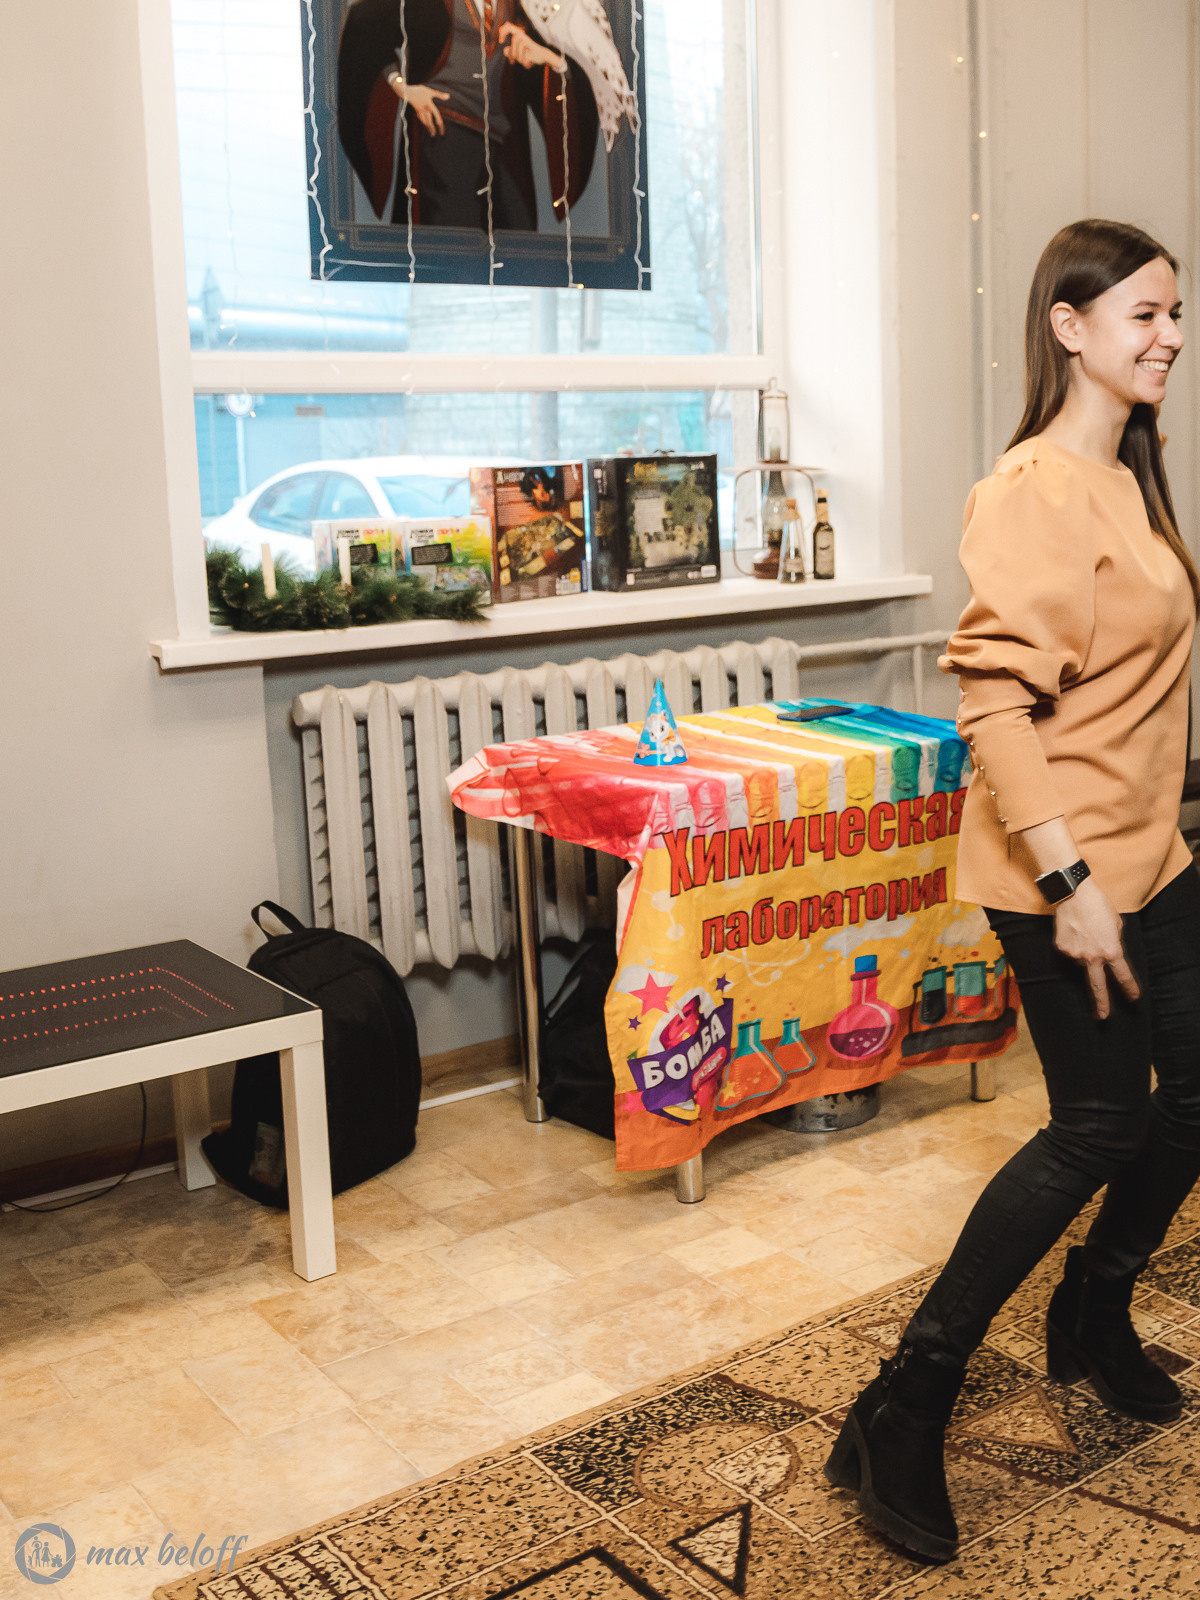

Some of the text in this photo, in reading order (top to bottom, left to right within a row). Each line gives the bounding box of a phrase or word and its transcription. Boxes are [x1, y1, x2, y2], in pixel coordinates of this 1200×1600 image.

[663, 787, 968, 897] Химическая
[700, 866, 948, 959] лаборатория
[641, 1013, 726, 1089] БОМБА
